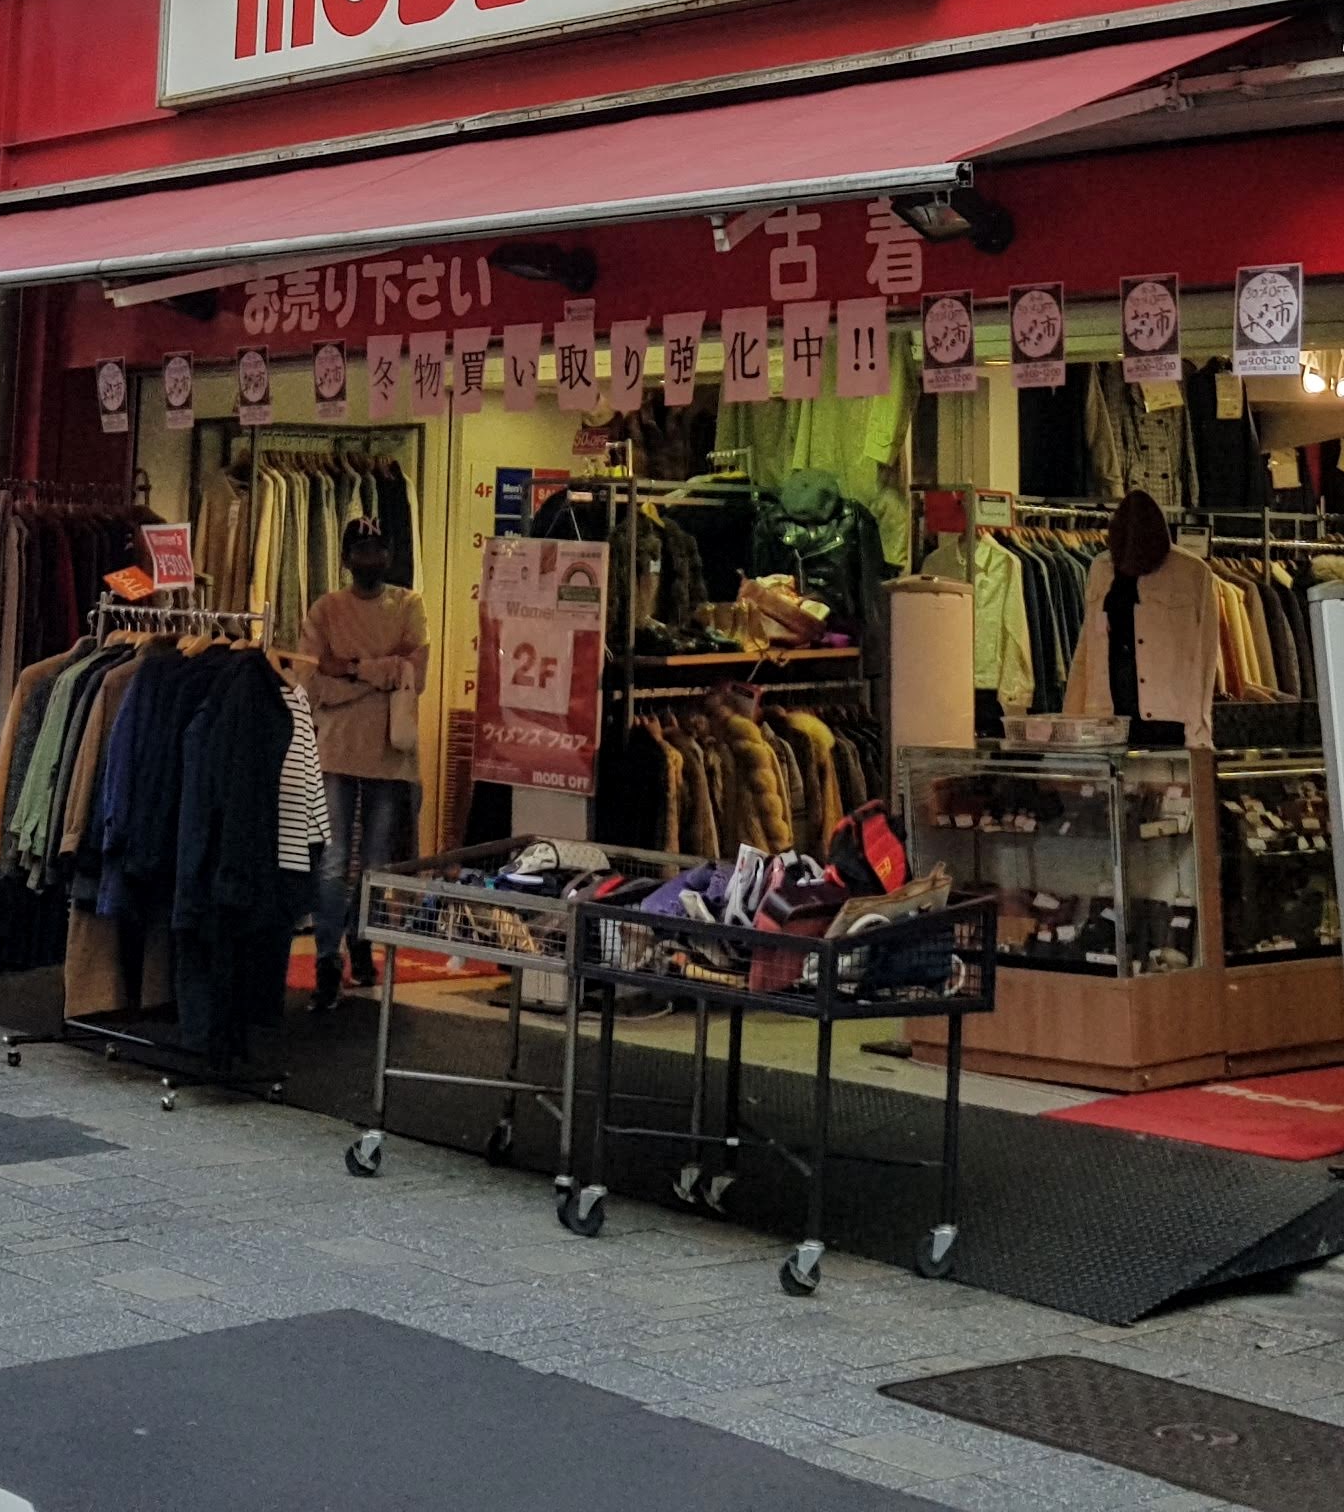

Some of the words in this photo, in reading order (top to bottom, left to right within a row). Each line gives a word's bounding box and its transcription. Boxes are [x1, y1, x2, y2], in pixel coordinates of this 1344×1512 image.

[765, 194, 924, 301] 古着
[243, 253, 492, 335] お売り下さい
[474, 482, 494, 499] 4F
[511, 642, 558, 689] 2F
[532, 771, 566, 788] MODE
